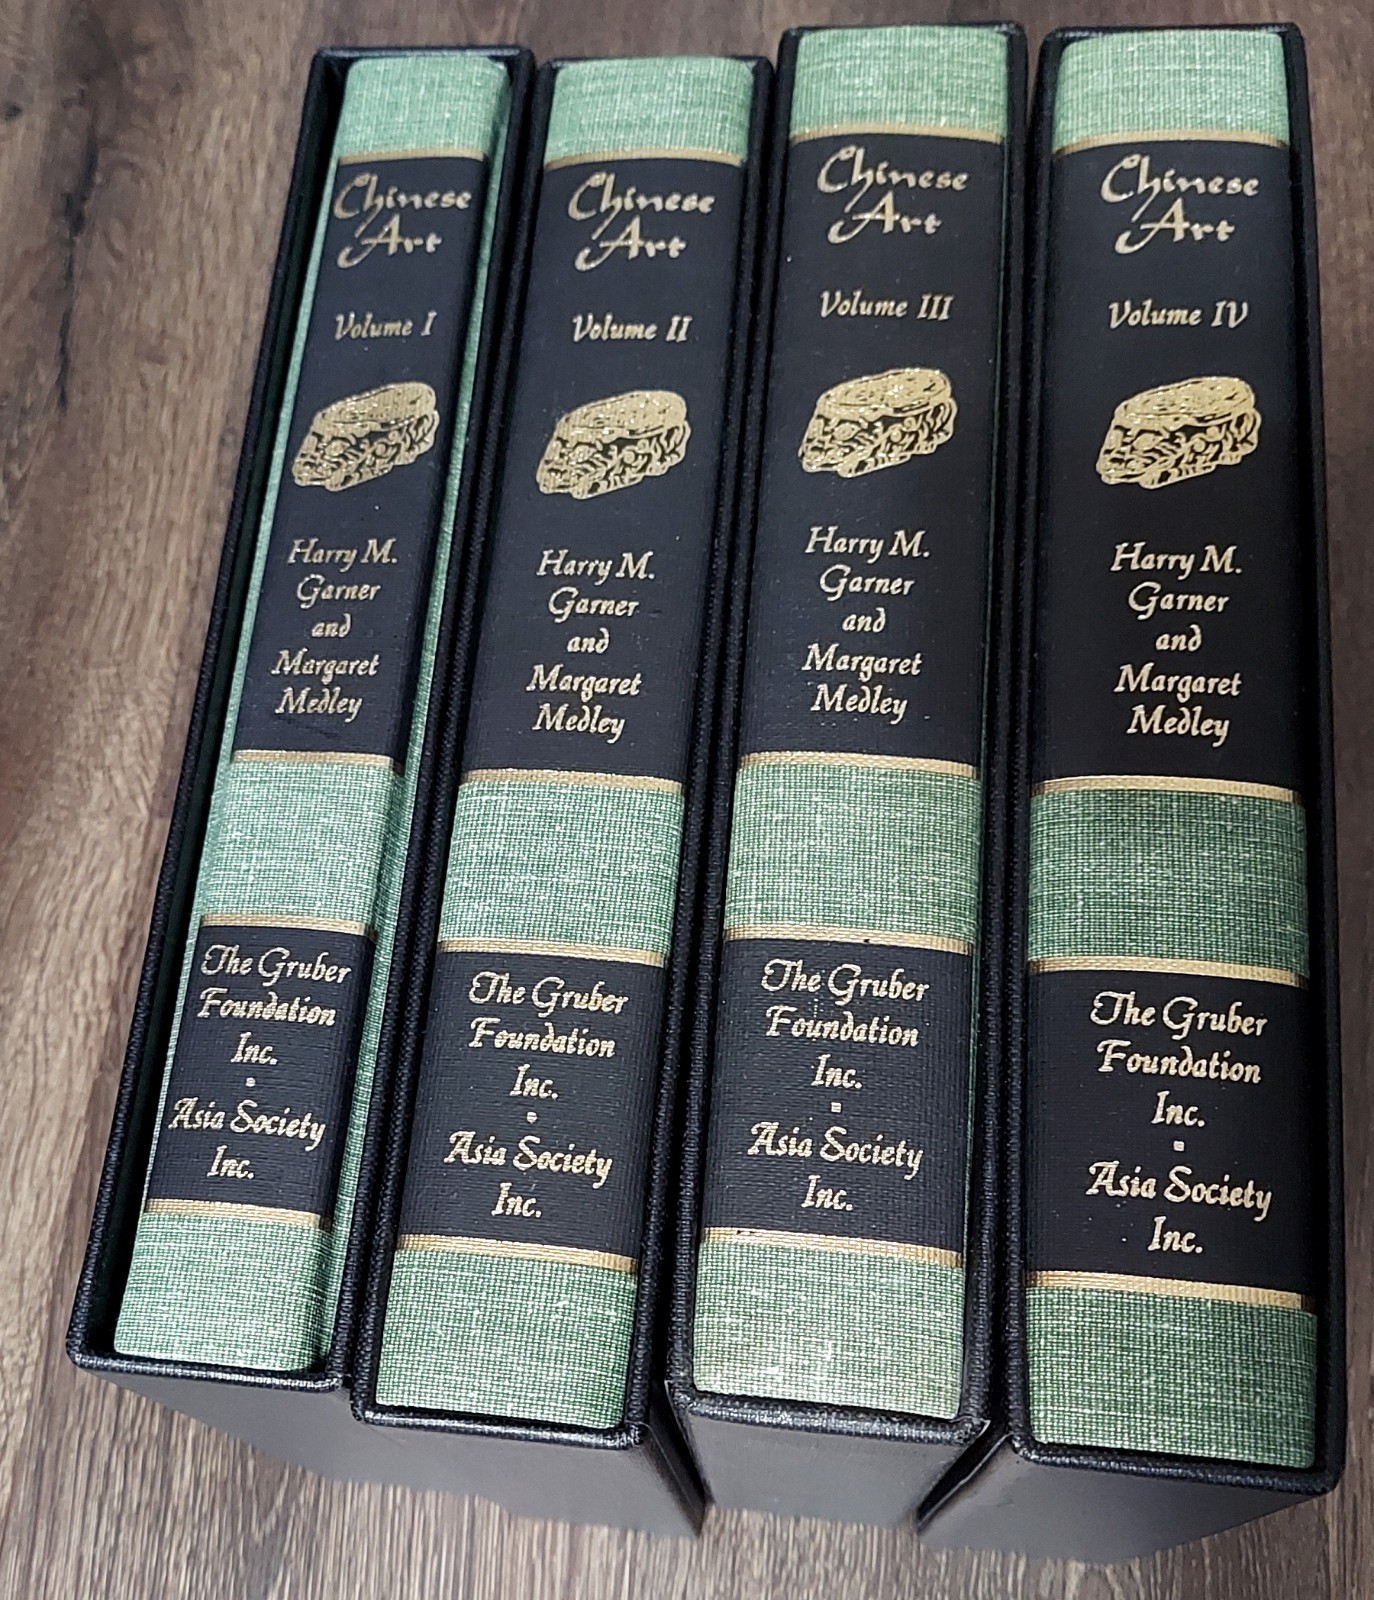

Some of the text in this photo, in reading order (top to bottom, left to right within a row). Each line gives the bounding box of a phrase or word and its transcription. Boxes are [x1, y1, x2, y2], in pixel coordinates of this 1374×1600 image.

[817, 144, 969, 212] Chinese
[1100, 154, 1259, 221] Chinese
[334, 172, 472, 237] Chinese
[568, 172, 716, 237] Chinese
[827, 190, 942, 243] Art
[337, 215, 442, 269] Art
[575, 216, 686, 270] Art
[1114, 198, 1235, 254] Art
[334, 310, 438, 340] Volume I
[820, 289, 954, 321] Volume III
[1108, 298, 1249, 329] Volume IV
[572, 312, 693, 343] Volume II
[287, 537, 398, 573] Harry M.
[804, 525, 930, 564] Harry M.
[1110, 541, 1242, 581] Harry M.
[535, 548, 655, 586] Harry M.
[819, 563, 915, 602] Garner
[296, 573, 382, 609] Garner
[548, 586, 640, 624] Garner
[1128, 581, 1230, 621] Garner
[311, 612, 351, 638] and
[841, 606, 886, 633] and
[1155, 624, 1202, 652] and
[566, 627, 610, 654] and
[270, 647, 380, 686] Margaret
[801, 642, 923, 683] Margaret
[1113, 662, 1242, 703] Margaret
[525, 663, 642, 703] Margaret
[274, 686, 363, 723] Medley
[531, 702, 626, 744] Medley
[809, 683, 908, 725] Medley
[1126, 704, 1230, 748] Medley
[200, 944, 352, 987] The Gruber
[760, 958, 930, 1007] The Gruber
[196, 987, 337, 1027] Foundation
[468, 970, 629, 1018] The Gruber
[765, 1004, 919, 1047] Foundation
[1090, 990, 1268, 1041] The Gruber
[230, 1031, 279, 1066] Inc.
[468, 1016, 616, 1058] Foundation
[509, 1063, 559, 1100] Inc.
[810, 1053, 863, 1090] Inc.
[1096, 1039, 1262, 1084] Foundation
[167, 1096, 327, 1152] Asia Society
[1150, 1090, 1206, 1128] Inc.
[206, 1144, 255, 1180] Inc.
[443, 1130, 613, 1189] Asia Society
[746, 1121, 924, 1181] Asia Society
[490, 1182, 542, 1219] Inc.
[800, 1174, 854, 1212] Inc.
[1085, 1160, 1272, 1222] Asia Society
[1147, 1215, 1203, 1254] Inc.
